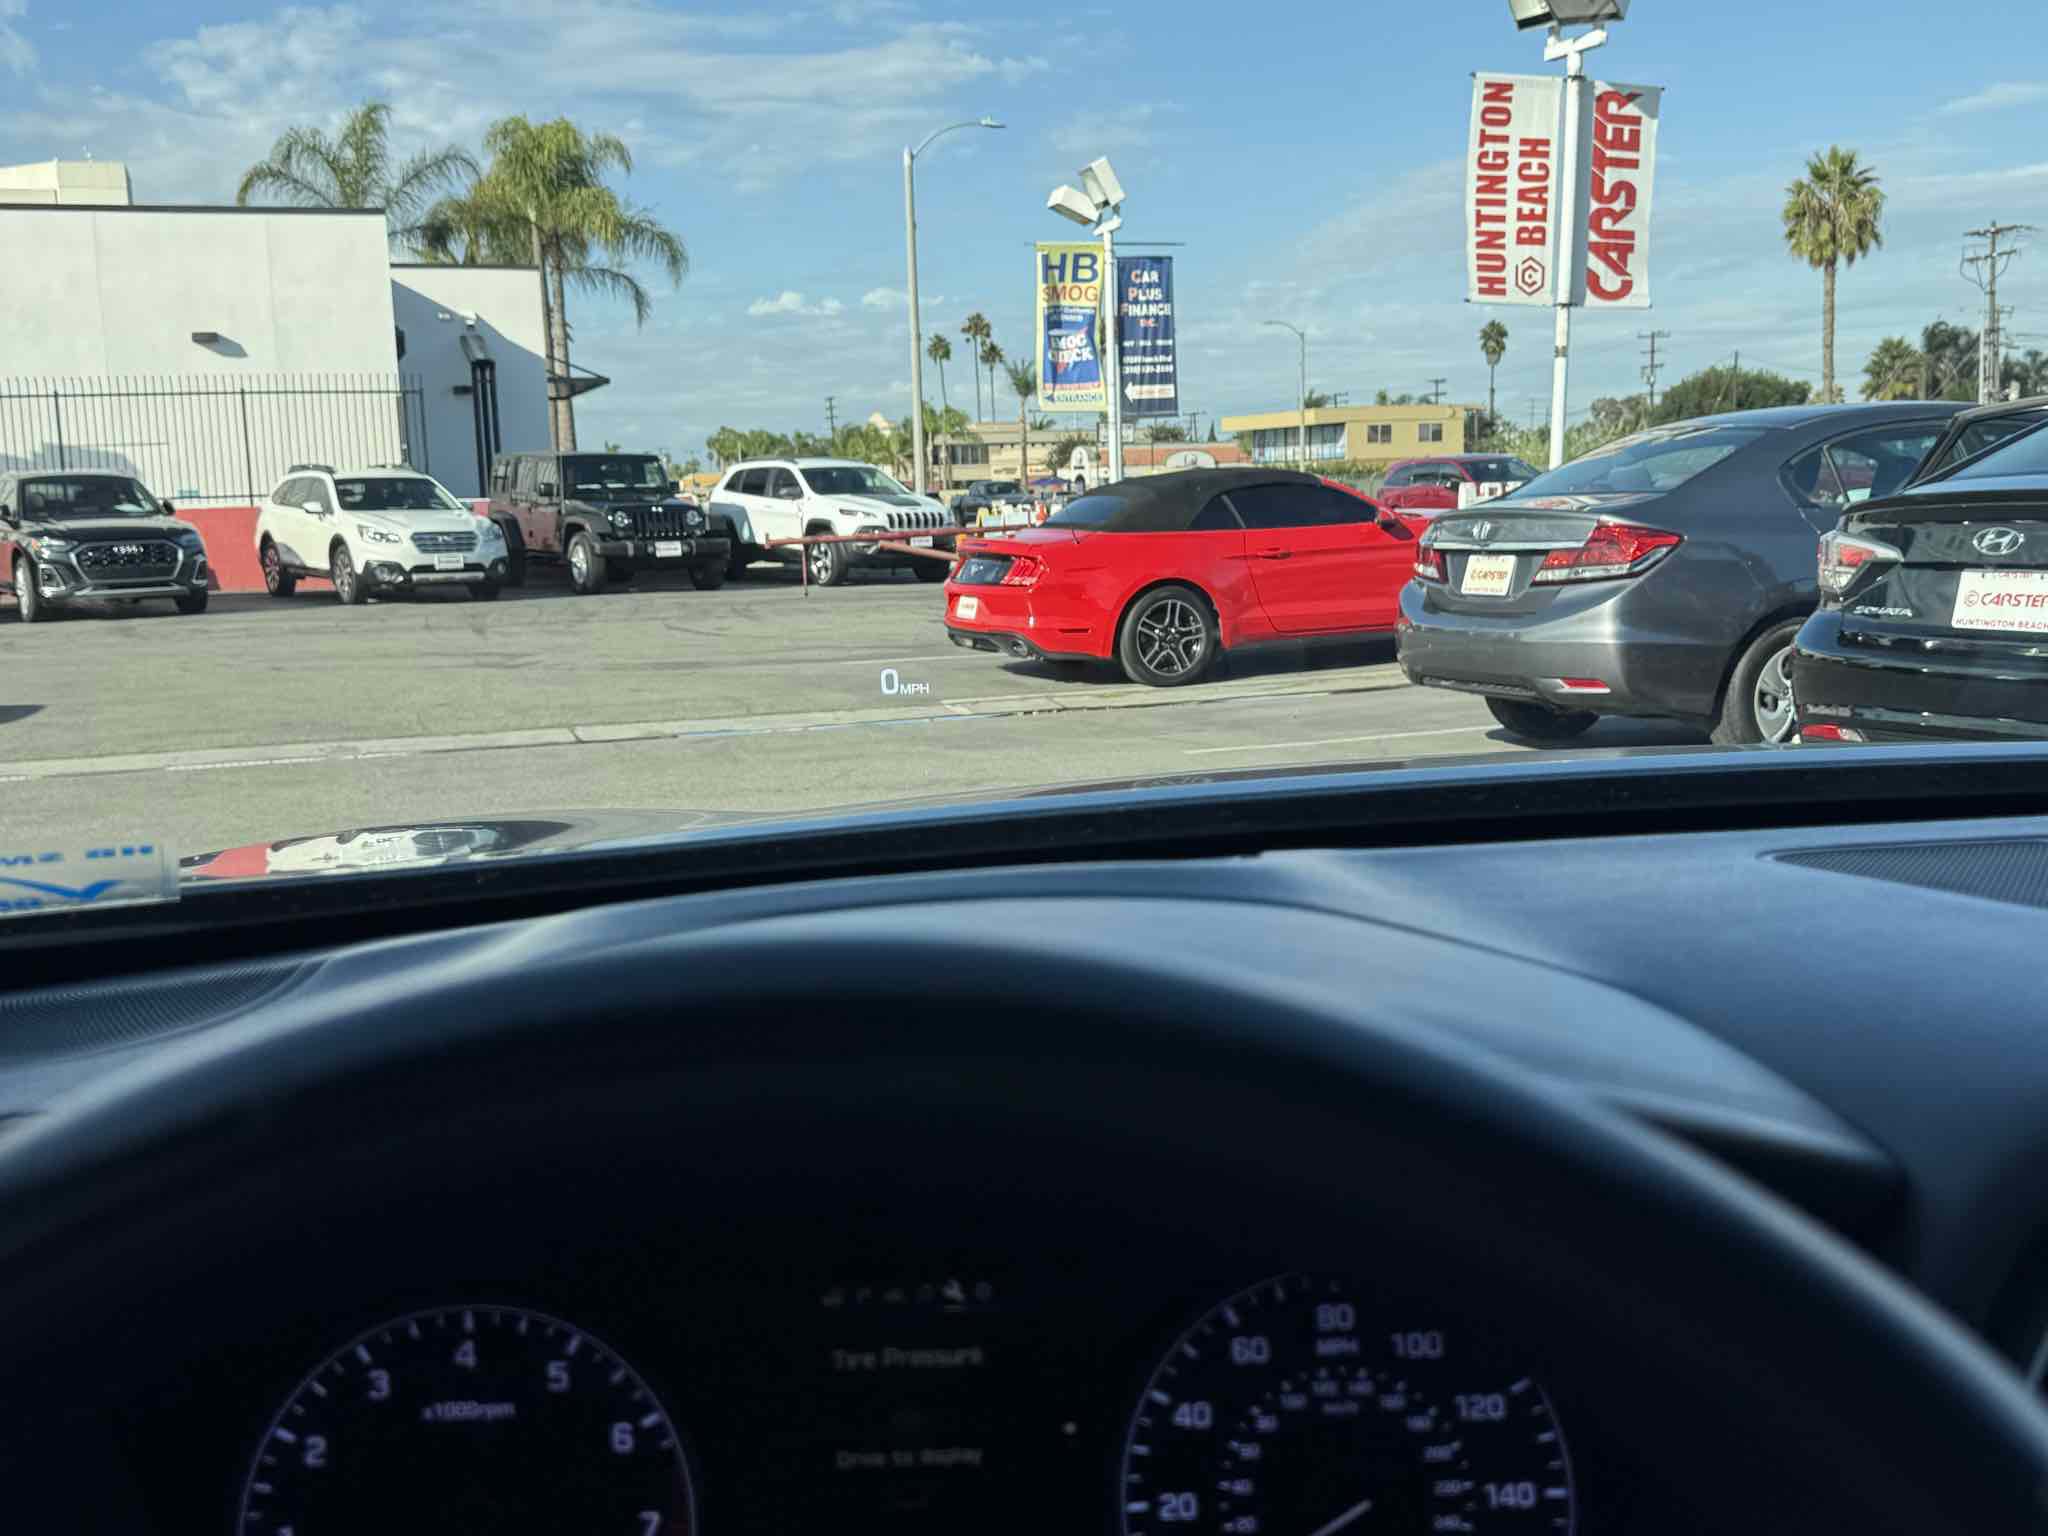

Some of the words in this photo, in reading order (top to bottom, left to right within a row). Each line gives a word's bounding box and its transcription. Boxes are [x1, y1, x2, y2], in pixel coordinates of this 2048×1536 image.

[1475, 81, 1514, 296] HUNTINGTON
[1516, 138, 1551, 246] BEACH
[1586, 90, 1644, 301] CARSTER
[1041, 252, 1098, 283] HB
[1131, 269, 1160, 283] CAR
[1042, 285, 1098, 302] SMOG
[1128, 287, 1163, 301] PLUS
[1120, 303, 1171, 317] FINANCE
[880, 668, 899, 695] 0
[900, 683, 929, 695] MPH
[453, 1338, 478, 1369] 4
[1230, 1336, 1270, 1365] 60
[1391, 1331, 1445, 1359] 100
[367, 1369, 391, 1401] 3
[546, 1360, 571, 1393] 5
[1171, 1401, 1213, 1430] 40
[1454, 1393, 1506, 1422] 120
[303, 1435, 328, 1468] 2
[609, 1421, 635, 1454] 6
[1158, 1491, 1198, 1521] 20
[1484, 1481, 1537, 1510] 140
[639, 1509, 662, 1536] 7
